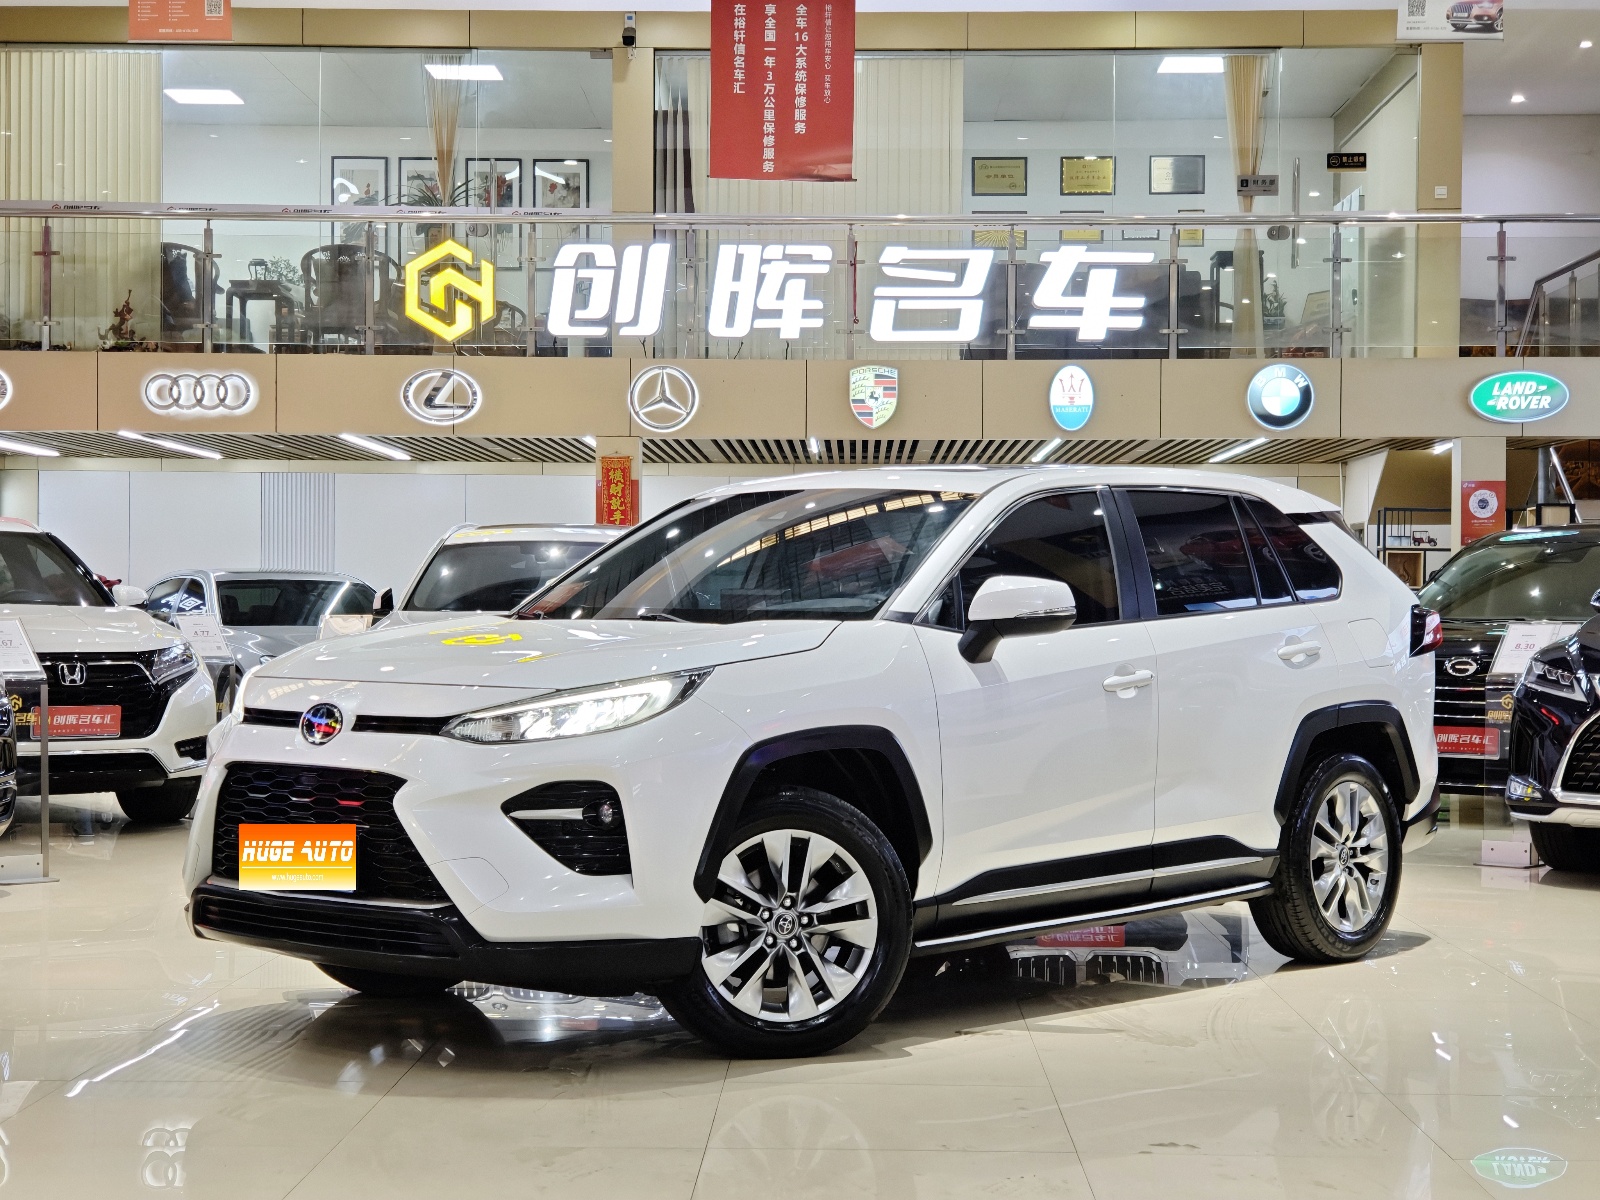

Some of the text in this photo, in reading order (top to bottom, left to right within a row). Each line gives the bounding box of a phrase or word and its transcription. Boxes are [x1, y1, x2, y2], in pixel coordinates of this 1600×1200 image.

[733, 3, 747, 94] 在裕轩信名车汇
[794, 3, 809, 134] 全车16大系统保修服务
[762, 3, 777, 173] 享全国一年3万公里保修服务
[547, 242, 1156, 343] 创晖名车
[851, 367, 897, 377] PORSCHE
[1254, 366, 1309, 389] BMW
[1492, 381, 1538, 396] LAND
[1495, 395, 1552, 410] ROVER
[53, 714, 117, 725] 创晖名车汇
[1436, 733, 1495, 745] 创晖名车汇
